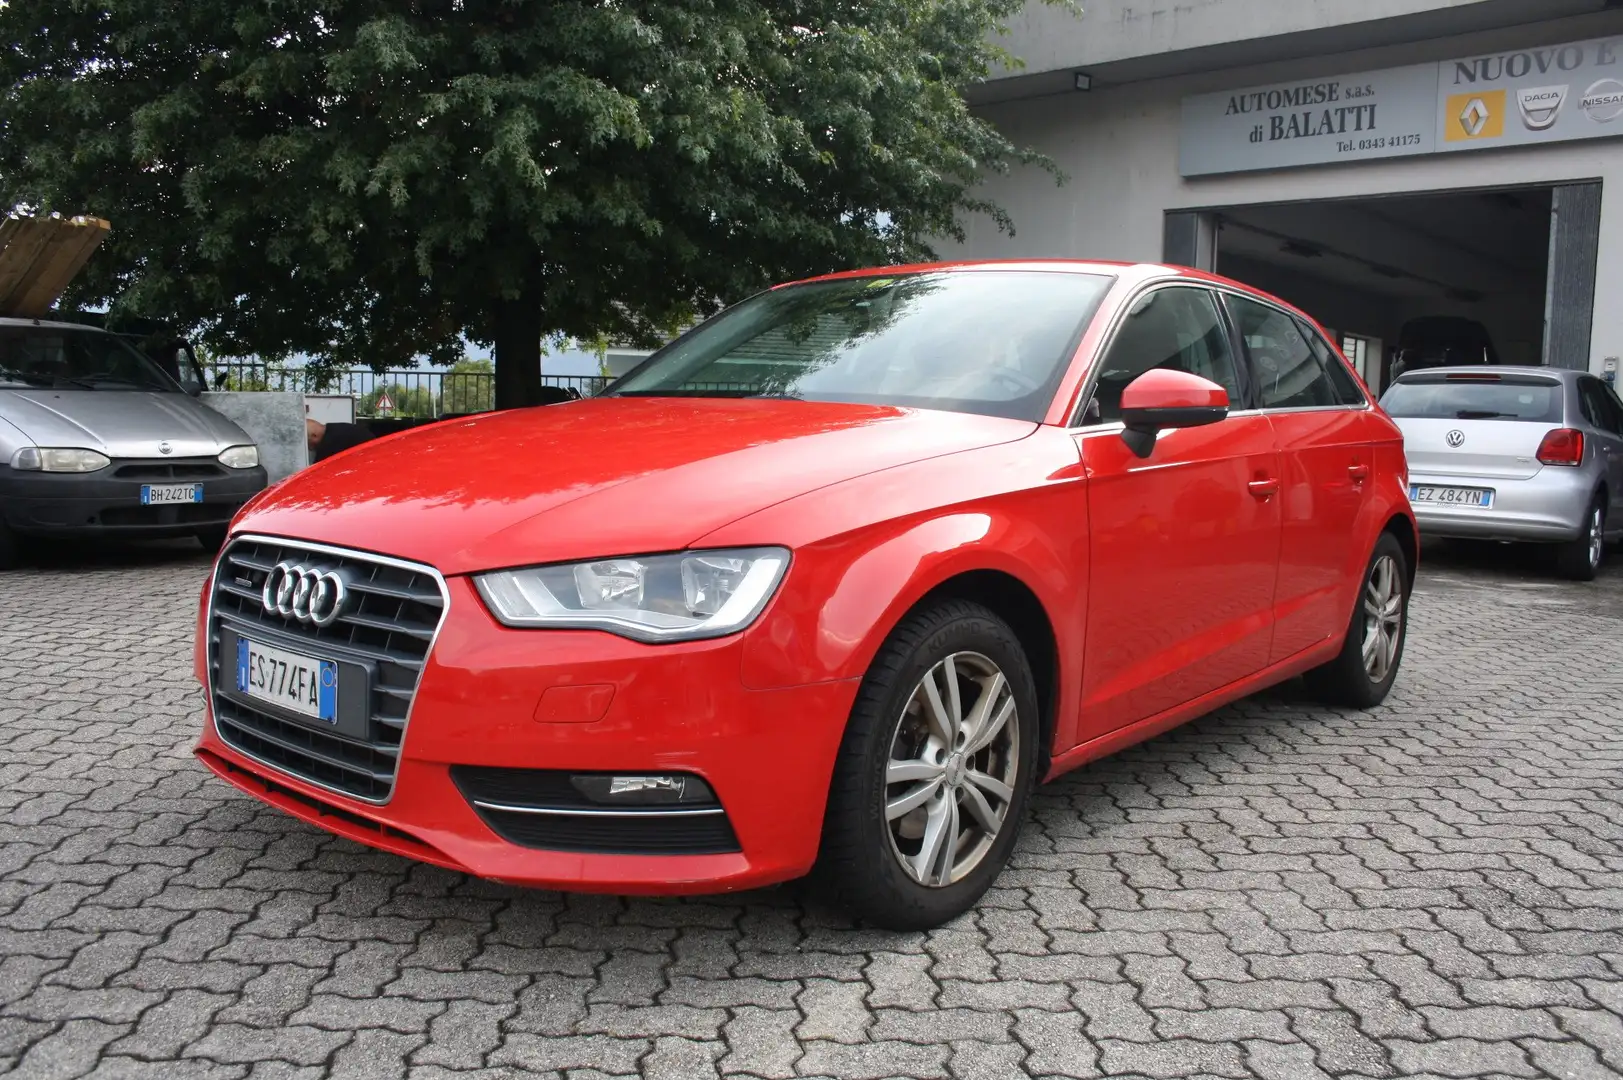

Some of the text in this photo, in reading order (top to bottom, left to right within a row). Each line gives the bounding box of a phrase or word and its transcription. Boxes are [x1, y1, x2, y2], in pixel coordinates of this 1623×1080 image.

[1453, 42, 1616, 85] NUOVO E
[1225, 81, 1375, 115] AUTOMESE s.a.s.
[1524, 92, 1560, 103] DACIA
[1249, 103, 1377, 143] di BALATTI
[1336, 134, 1421, 153] Tel. 0343 41175
